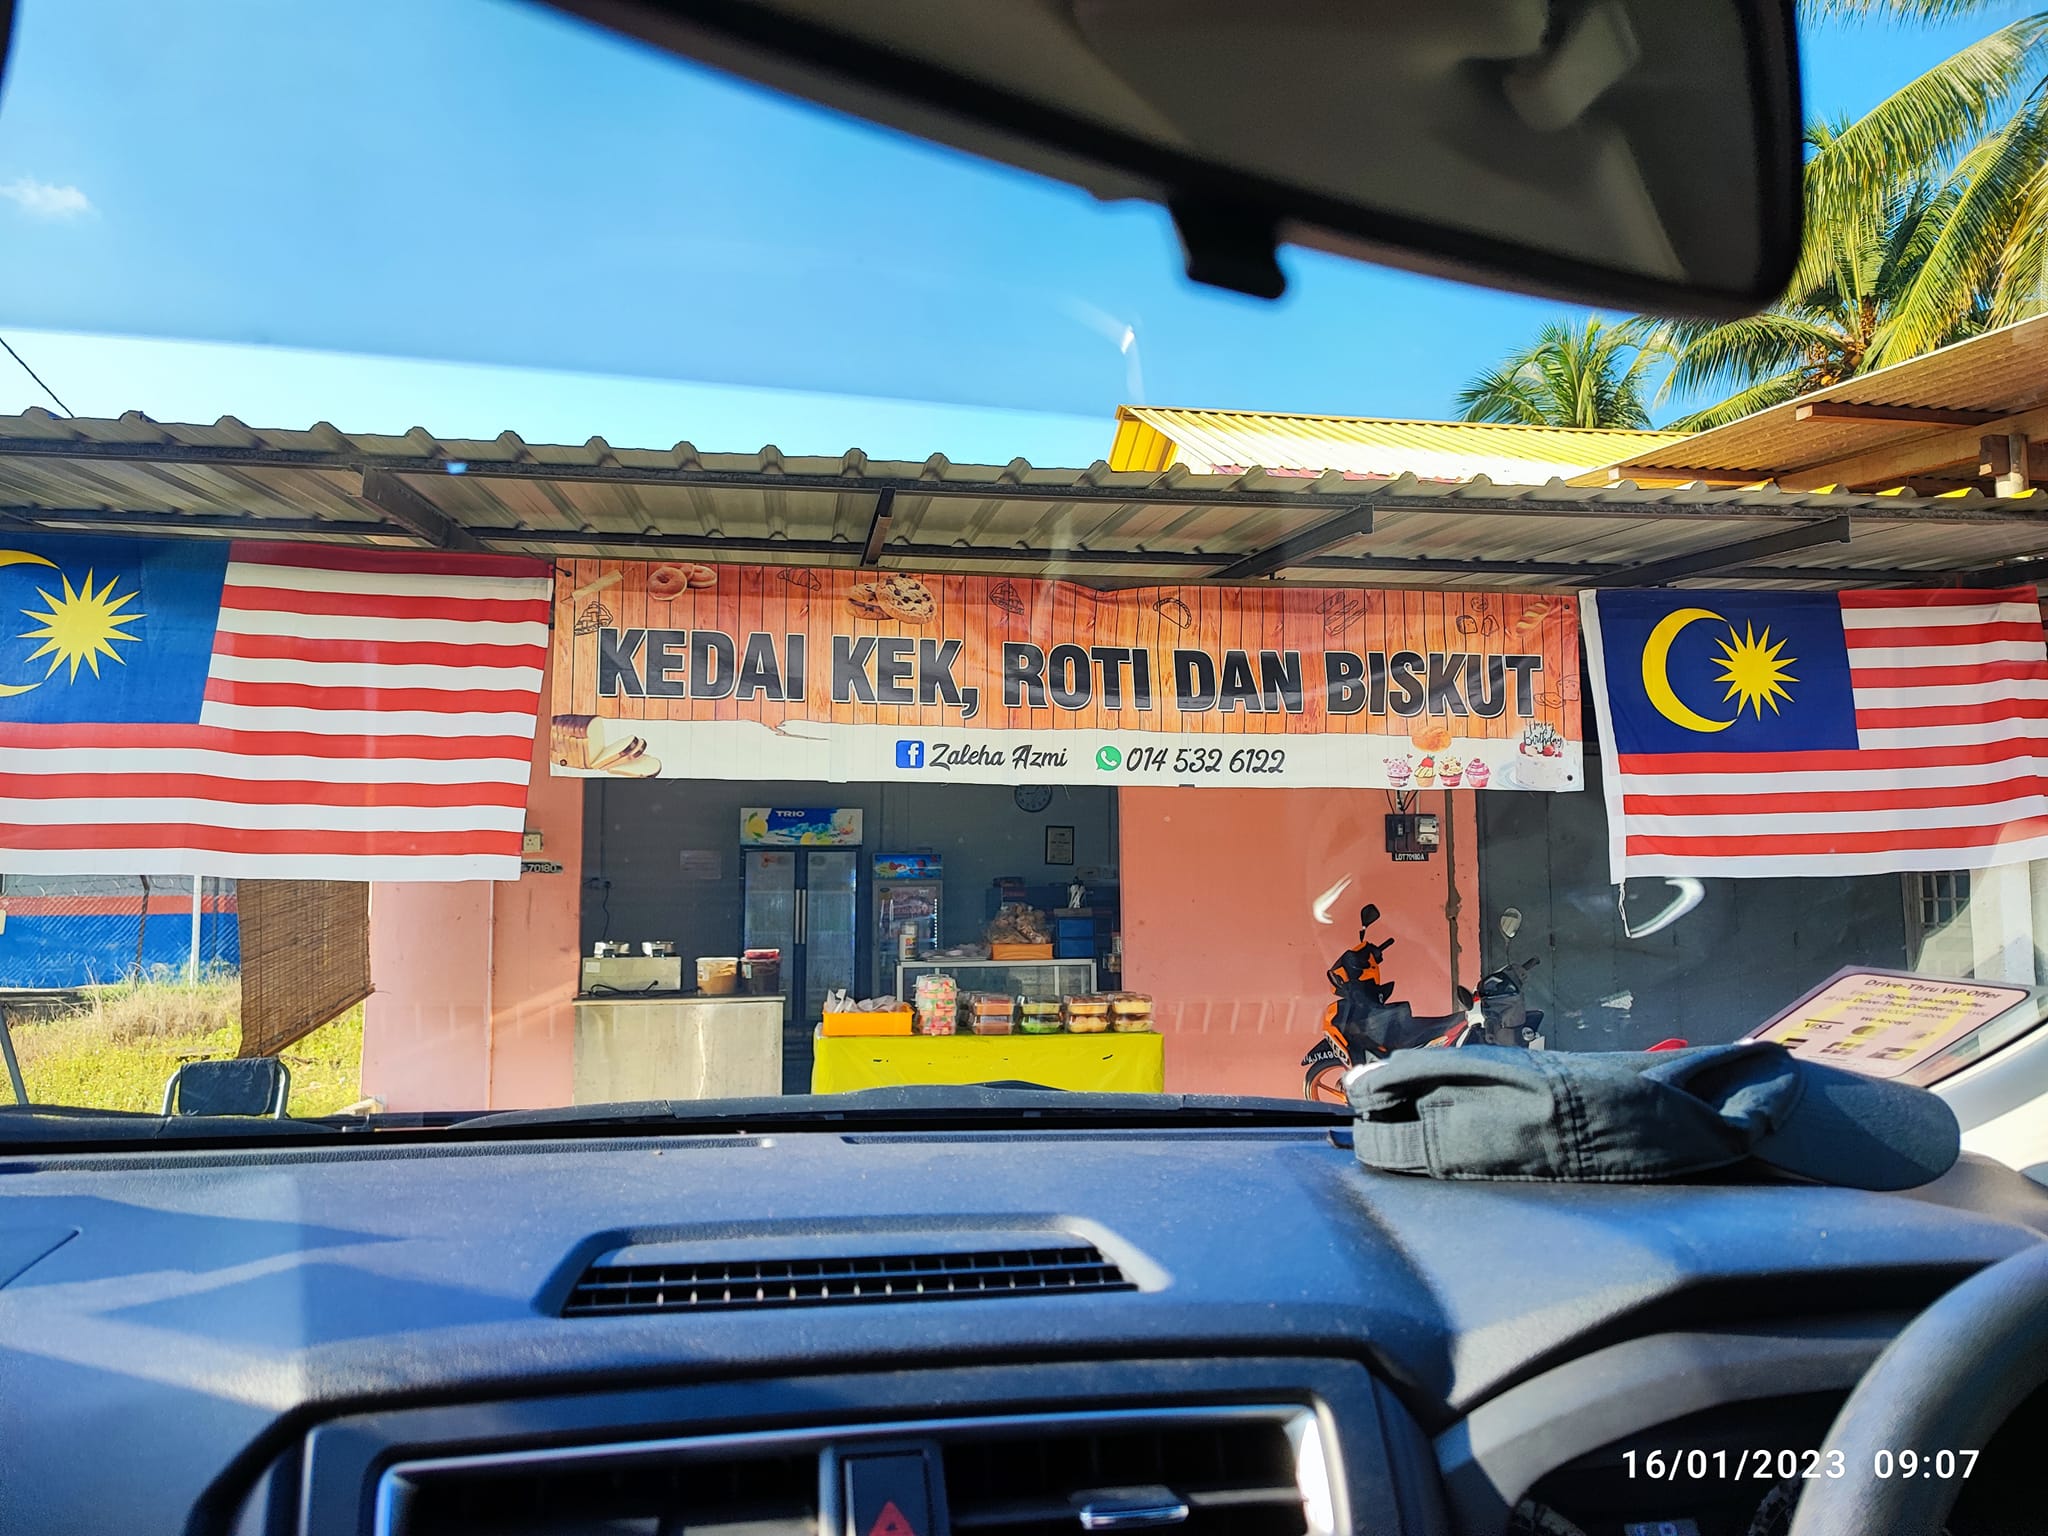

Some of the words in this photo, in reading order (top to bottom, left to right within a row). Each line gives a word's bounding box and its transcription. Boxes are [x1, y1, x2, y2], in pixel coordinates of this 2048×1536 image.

[598, 627, 806, 702] KEDAI
[832, 634, 980, 719] KEK,
[1002, 641, 1154, 713] ROTI
[1173, 648, 1303, 715] DAN
[1325, 650, 1545, 718] BISKUT
[928, 743, 1005, 771] Zaleha
[1012, 744, 1068, 770] Azmi
[1126, 747, 1167, 772] 014
[1173, 747, 1222, 773] 532
[1229, 748, 1286, 774] 6122
[1864, 979, 1940, 993] Drive-Thru
[1941, 986, 1967, 995] VIP
[1966, 989, 2003, 999] Offer
